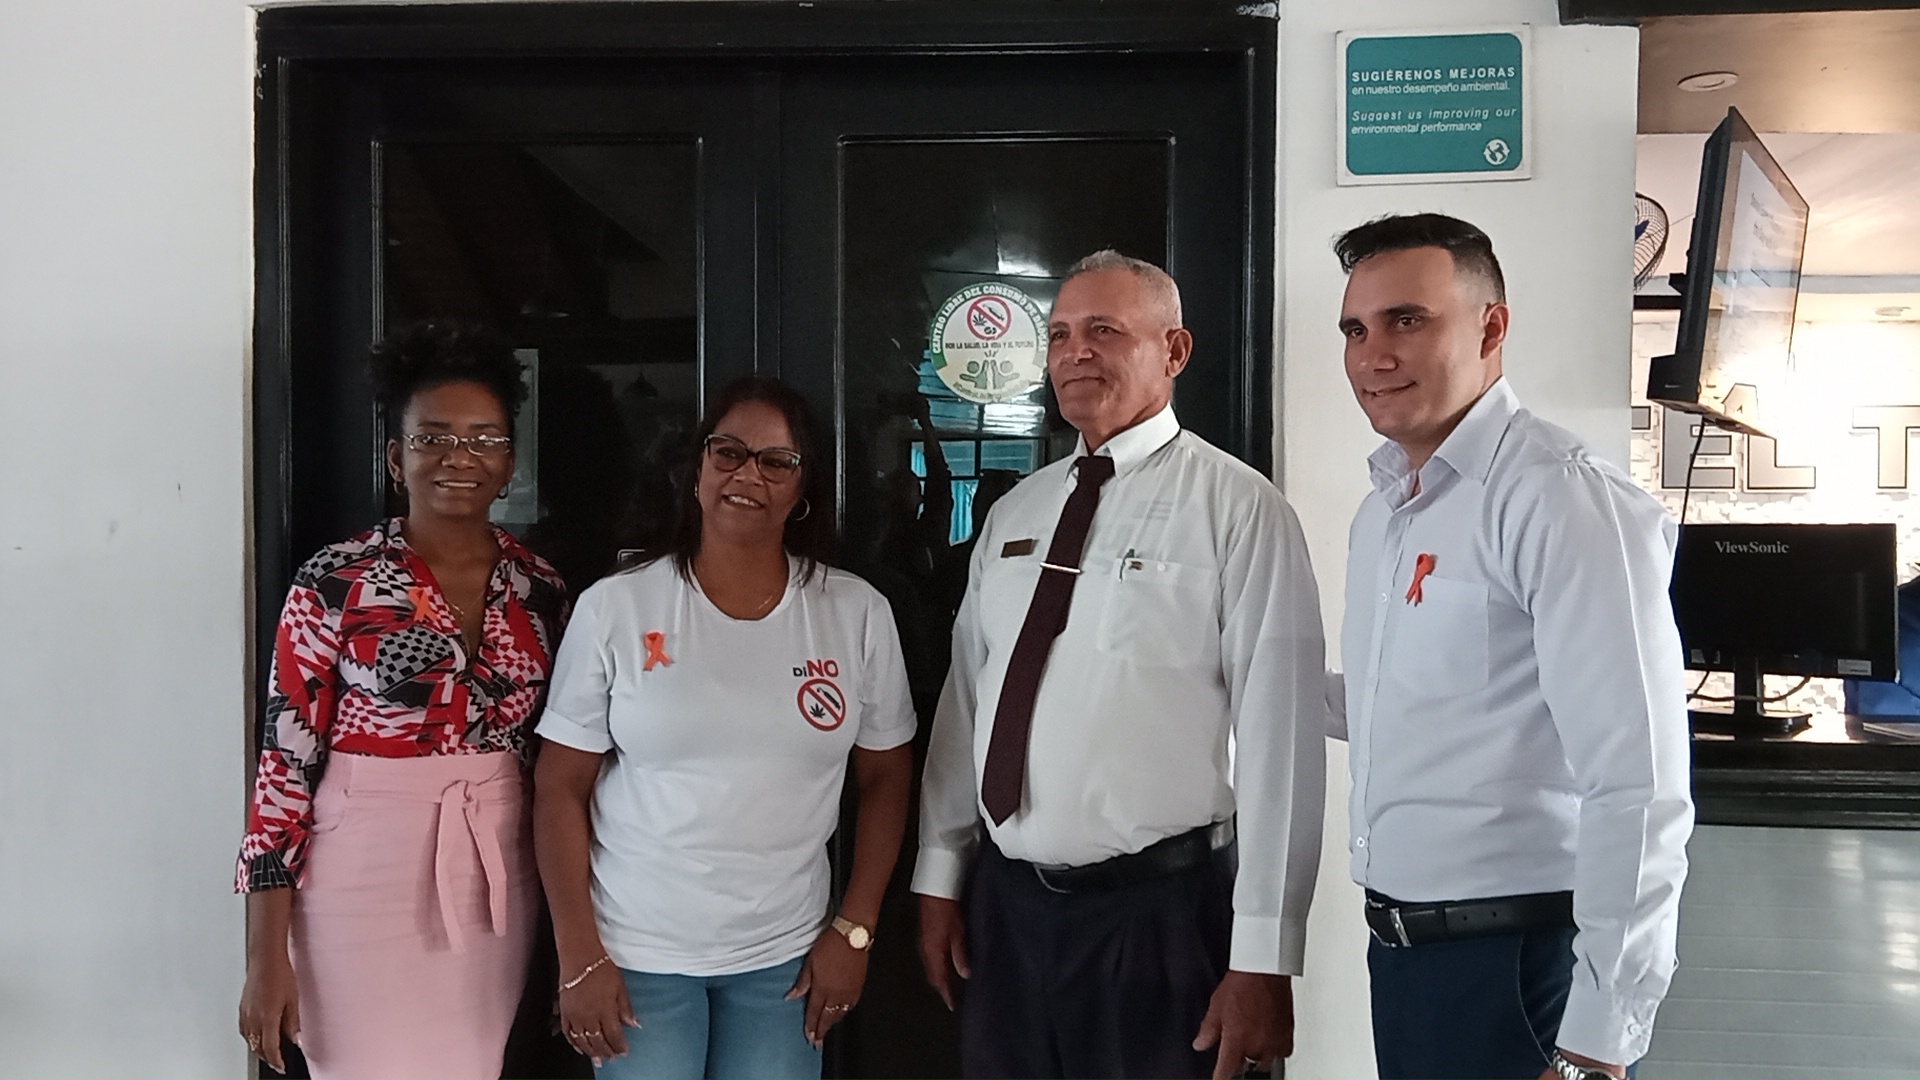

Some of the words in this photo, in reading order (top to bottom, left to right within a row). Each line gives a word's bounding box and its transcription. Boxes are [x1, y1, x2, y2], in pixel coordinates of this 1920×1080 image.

[1352, 69, 1442, 82] SUGIÉRENOS
[1449, 67, 1516, 79] MEJORAS
[1352, 87, 1364, 95] en
[1366, 84, 1401, 94] nuestro
[1403, 83, 1459, 94] desempeño
[1461, 81, 1510, 91] ambiental.
[1352, 110, 1402, 122] Suggest
[1408, 111, 1422, 120] us
[1429, 108, 1489, 120] improving
[1496, 107, 1517, 116] our
[1351, 123, 1418, 135] environmental
[1419, 121, 1482, 133] performance
[943, 295, 965, 318] LIBRE
[964, 287, 982, 299] DEL
[983, 285, 1025, 306] CONSUMO
[1024, 302, 1038, 317] DE
[1715, 540, 1789, 553] ViewSonic
